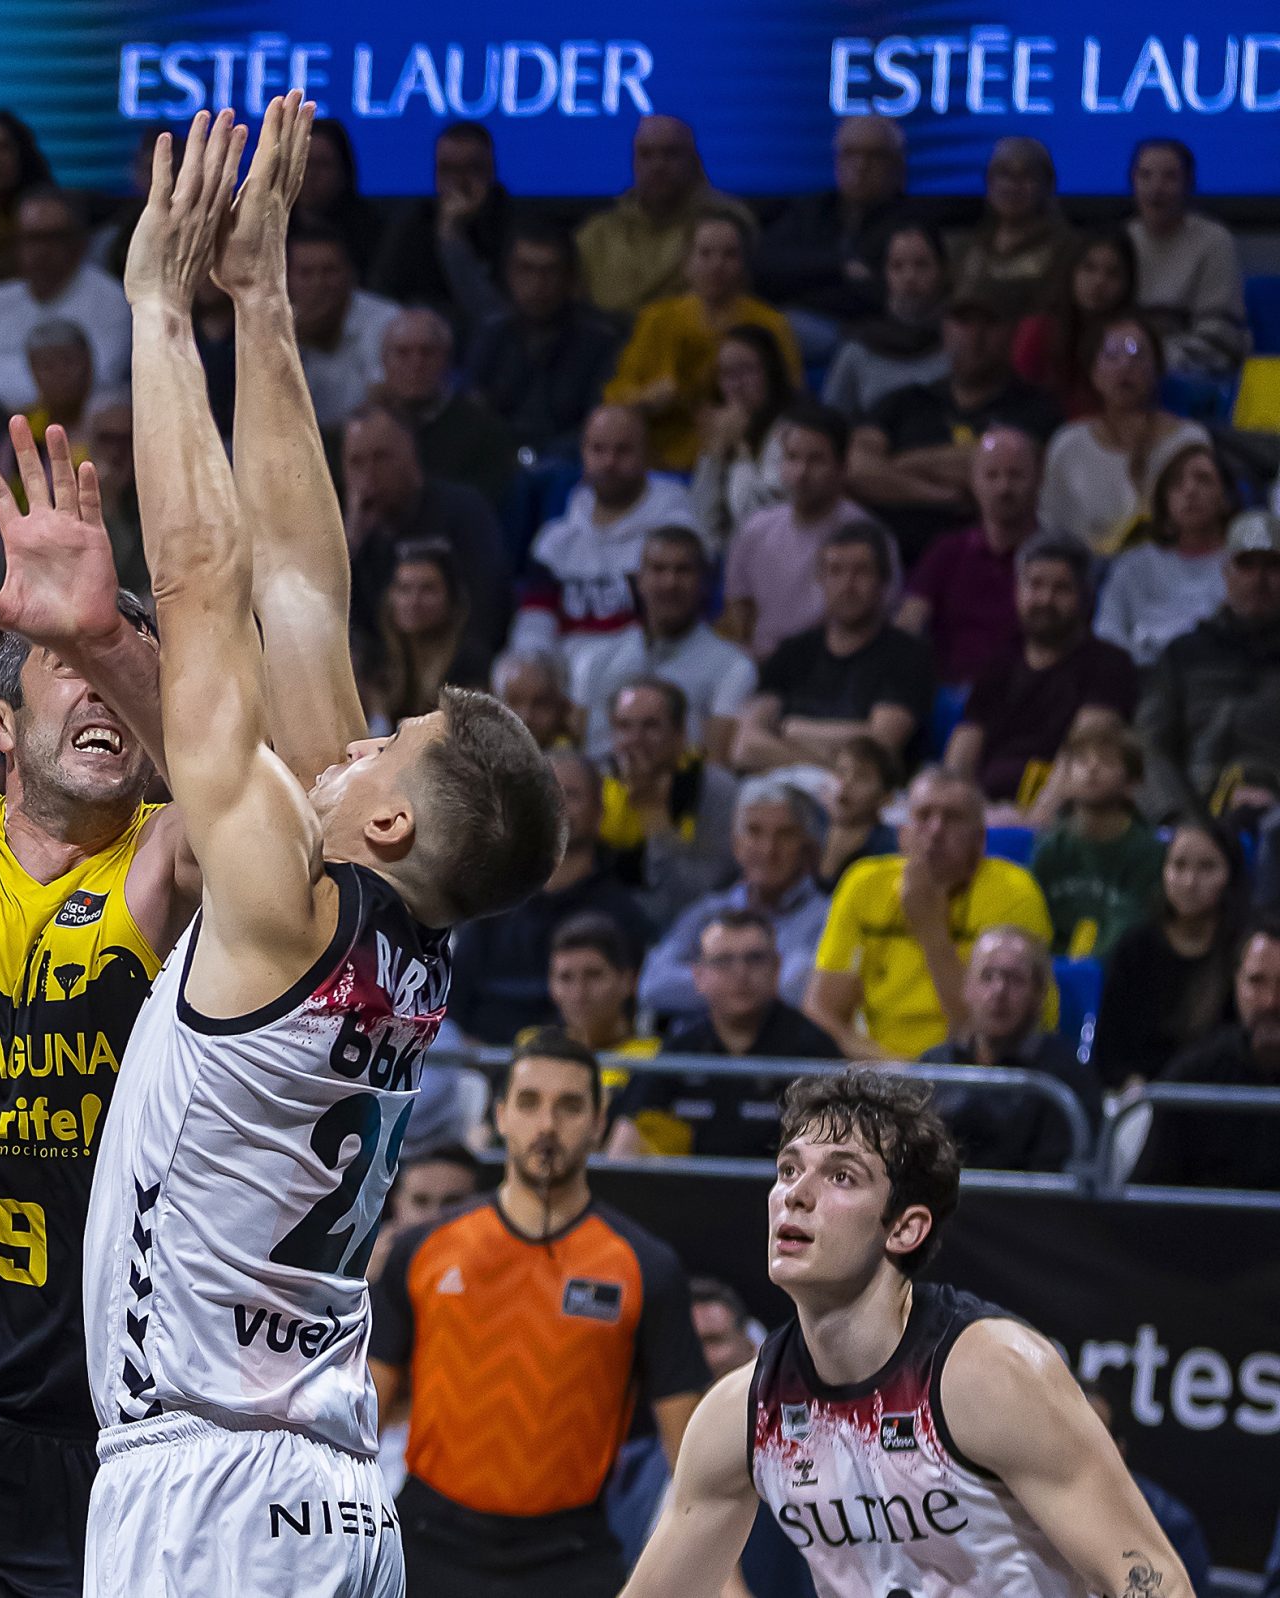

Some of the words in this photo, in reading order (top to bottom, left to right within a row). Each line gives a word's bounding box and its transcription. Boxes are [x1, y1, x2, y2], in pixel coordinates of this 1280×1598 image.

[351, 38, 655, 119] LAUDER
[64, 900, 87, 914] liga
[1050, 1322, 1280, 1436] rtes
[778, 1488, 969, 1548] surne
